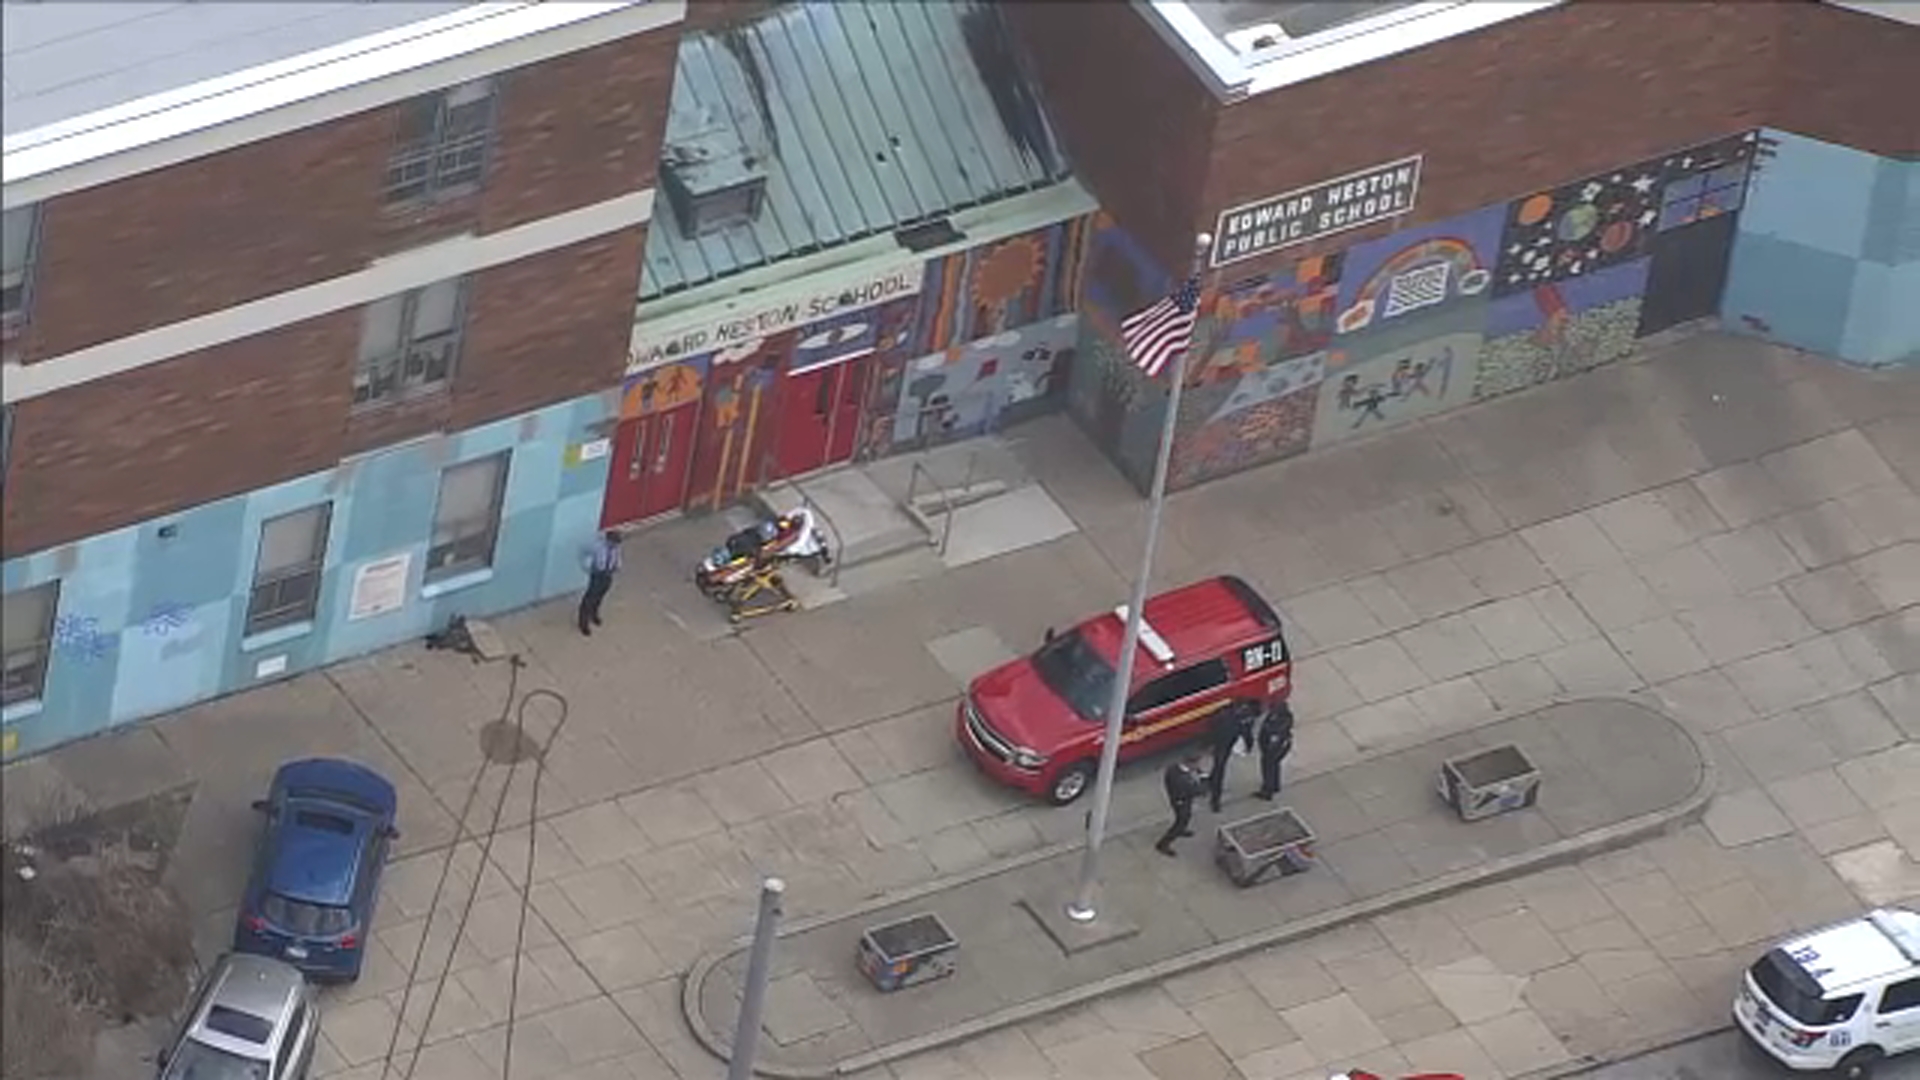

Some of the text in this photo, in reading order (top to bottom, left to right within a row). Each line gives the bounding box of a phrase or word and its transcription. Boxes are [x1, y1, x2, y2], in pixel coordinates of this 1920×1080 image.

[1223, 192, 1406, 256] PUBLIC SCHOOL
[1228, 168, 1411, 235] EDWARD HESTON
[716, 304, 799, 340] HESTON
[809, 274, 912, 317] SCHOOL
